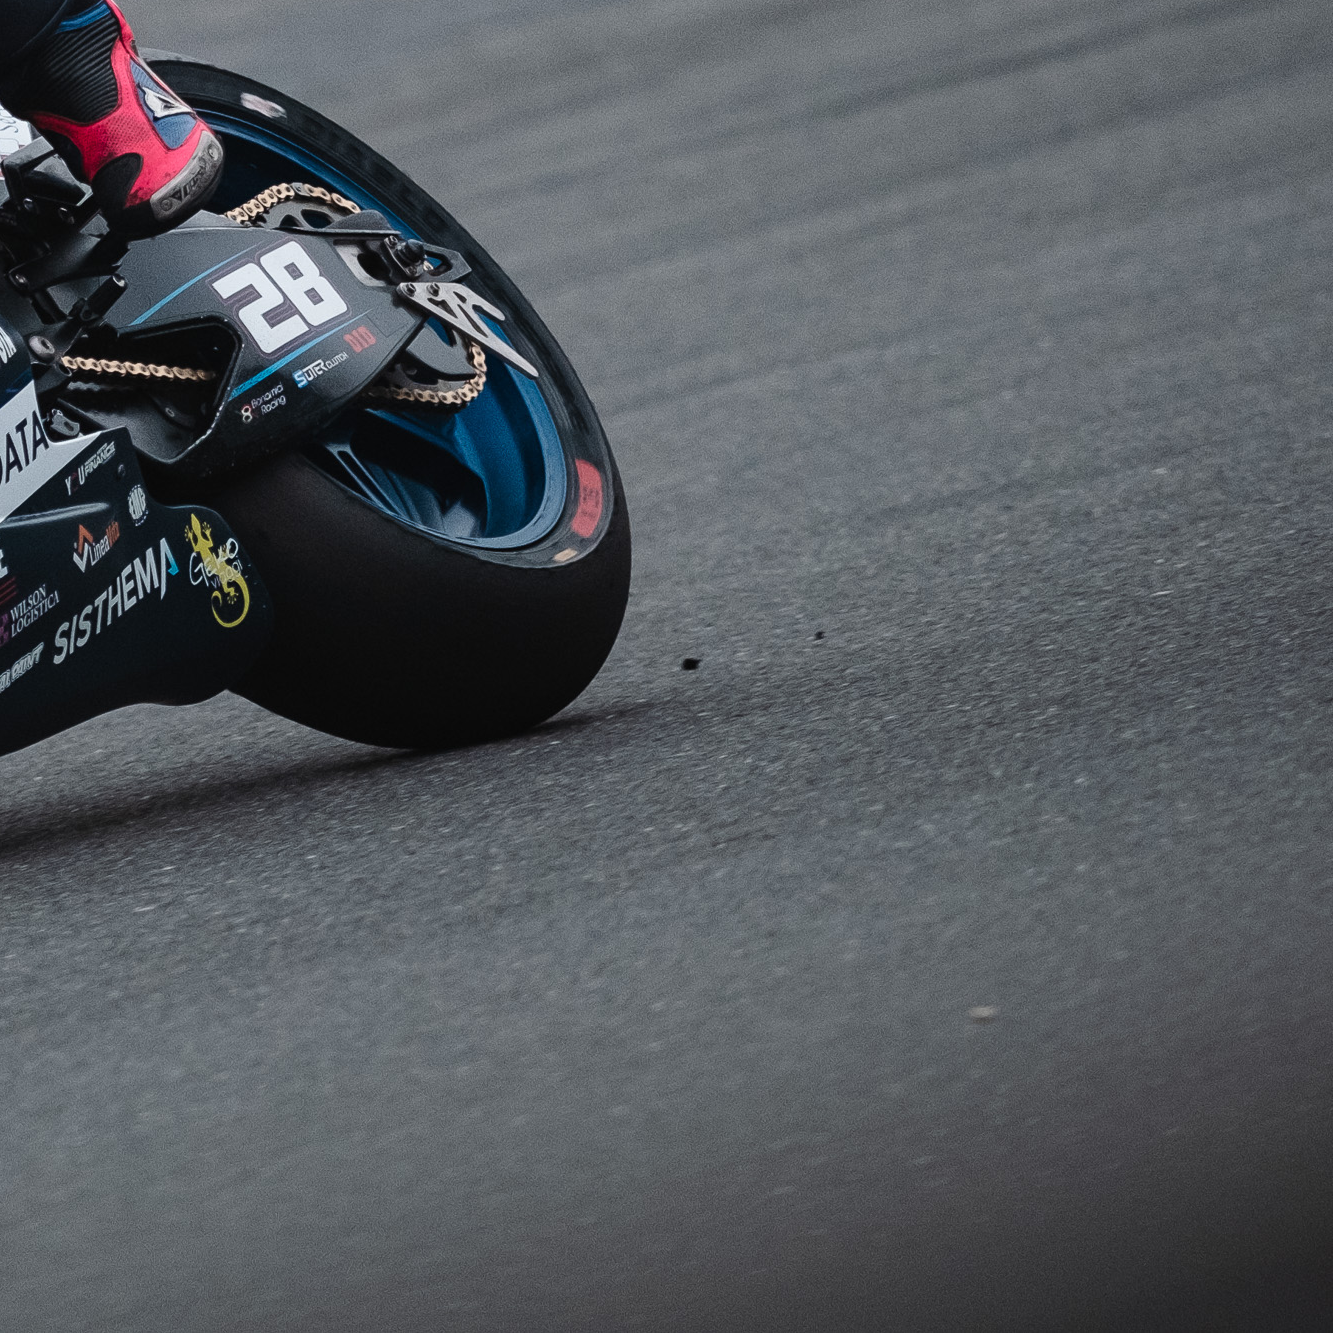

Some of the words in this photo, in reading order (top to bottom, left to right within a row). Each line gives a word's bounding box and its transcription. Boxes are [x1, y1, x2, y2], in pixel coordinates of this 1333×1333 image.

[212, 240, 348, 354] 28
[10, 584, 47, 622] WILSON
[11, 590, 60, 638] LOGISTICA
